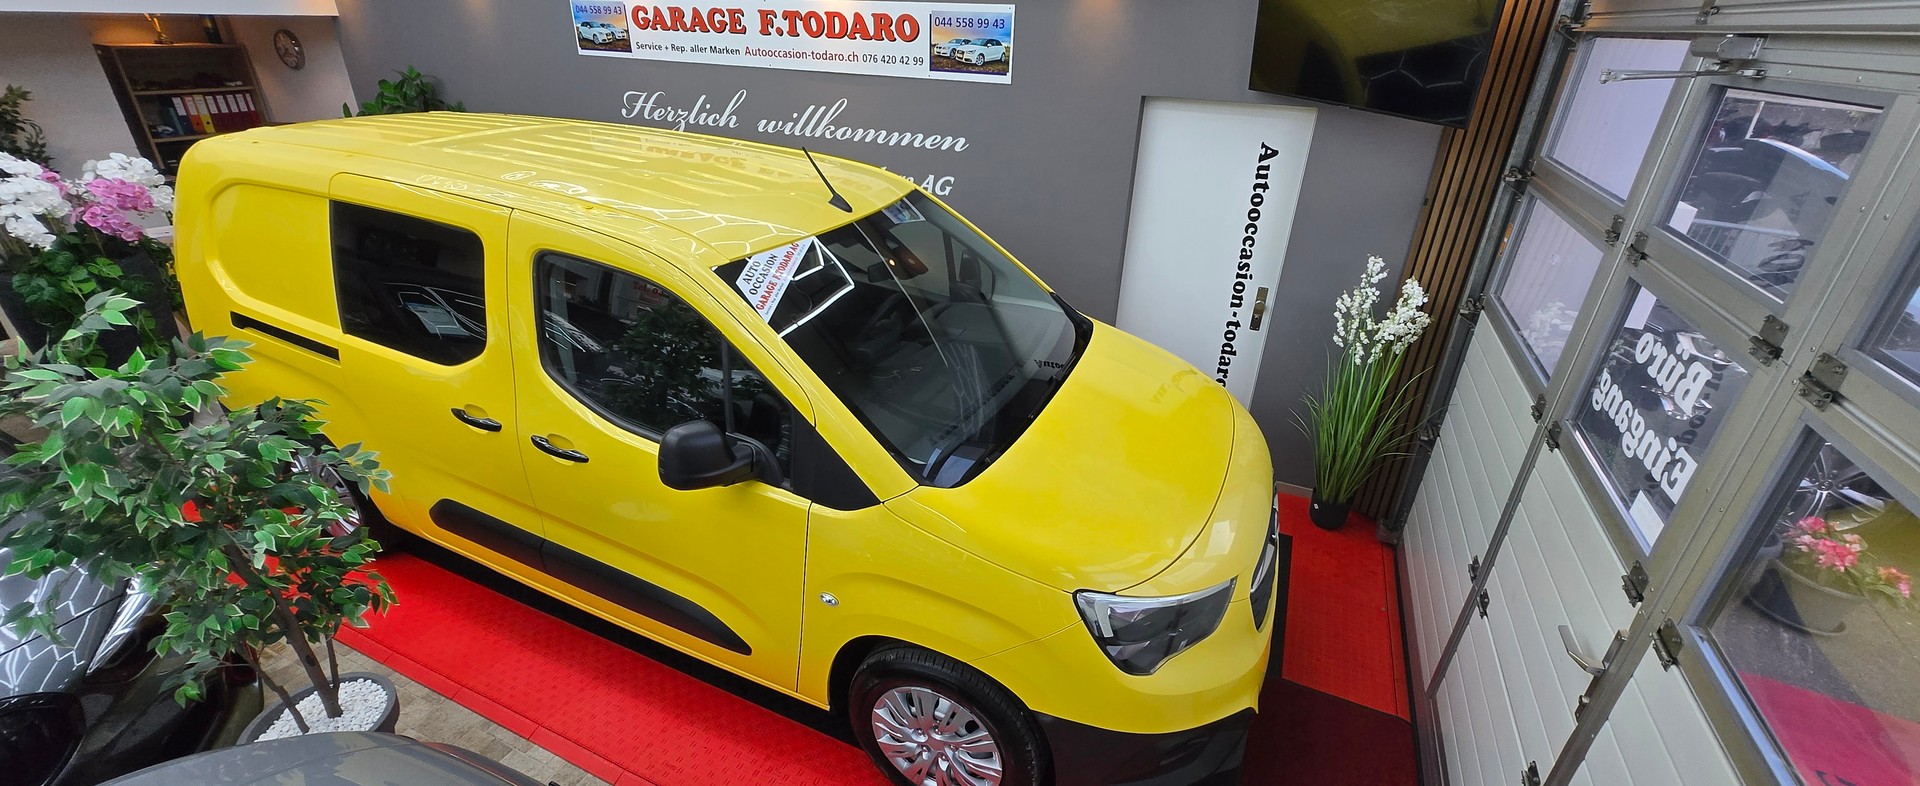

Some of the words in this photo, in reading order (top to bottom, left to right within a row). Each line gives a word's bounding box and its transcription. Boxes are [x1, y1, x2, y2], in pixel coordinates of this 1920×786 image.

[576, 5, 588, 14] 044
[589, 5, 602, 15] 558
[603, 6, 612, 15] 99
[613, 6, 622, 15] 43
[934, 16, 952, 27] 044
[955, 17, 974, 28] 558
[977, 18, 990, 29] 99
[992, 18, 1005, 29] 43
[631, 5, 747, 35] GARAGE
[757, 9, 920, 42] F.TODARO
[636, 41, 663, 51] Service
[670, 43, 688, 54] Rep.
[690, 44, 708, 54] aller
[709, 45, 741, 56] Marken
[744, 46, 859, 63] Autooccasion-todaro.ch
[862, 54, 878, 64] 076
[880, 55, 897, 65] 420
[899, 56, 910, 65] 42
[913, 56, 924, 66] 99
[621, 89, 747, 133] Herzlich
[757, 98, 970, 153] willkommen
[920, 174, 955, 196] AG
[742, 260, 761, 285] AUTO
[748, 253, 779, 296] OCCASION
[755, 281, 778, 311] GARAGE
